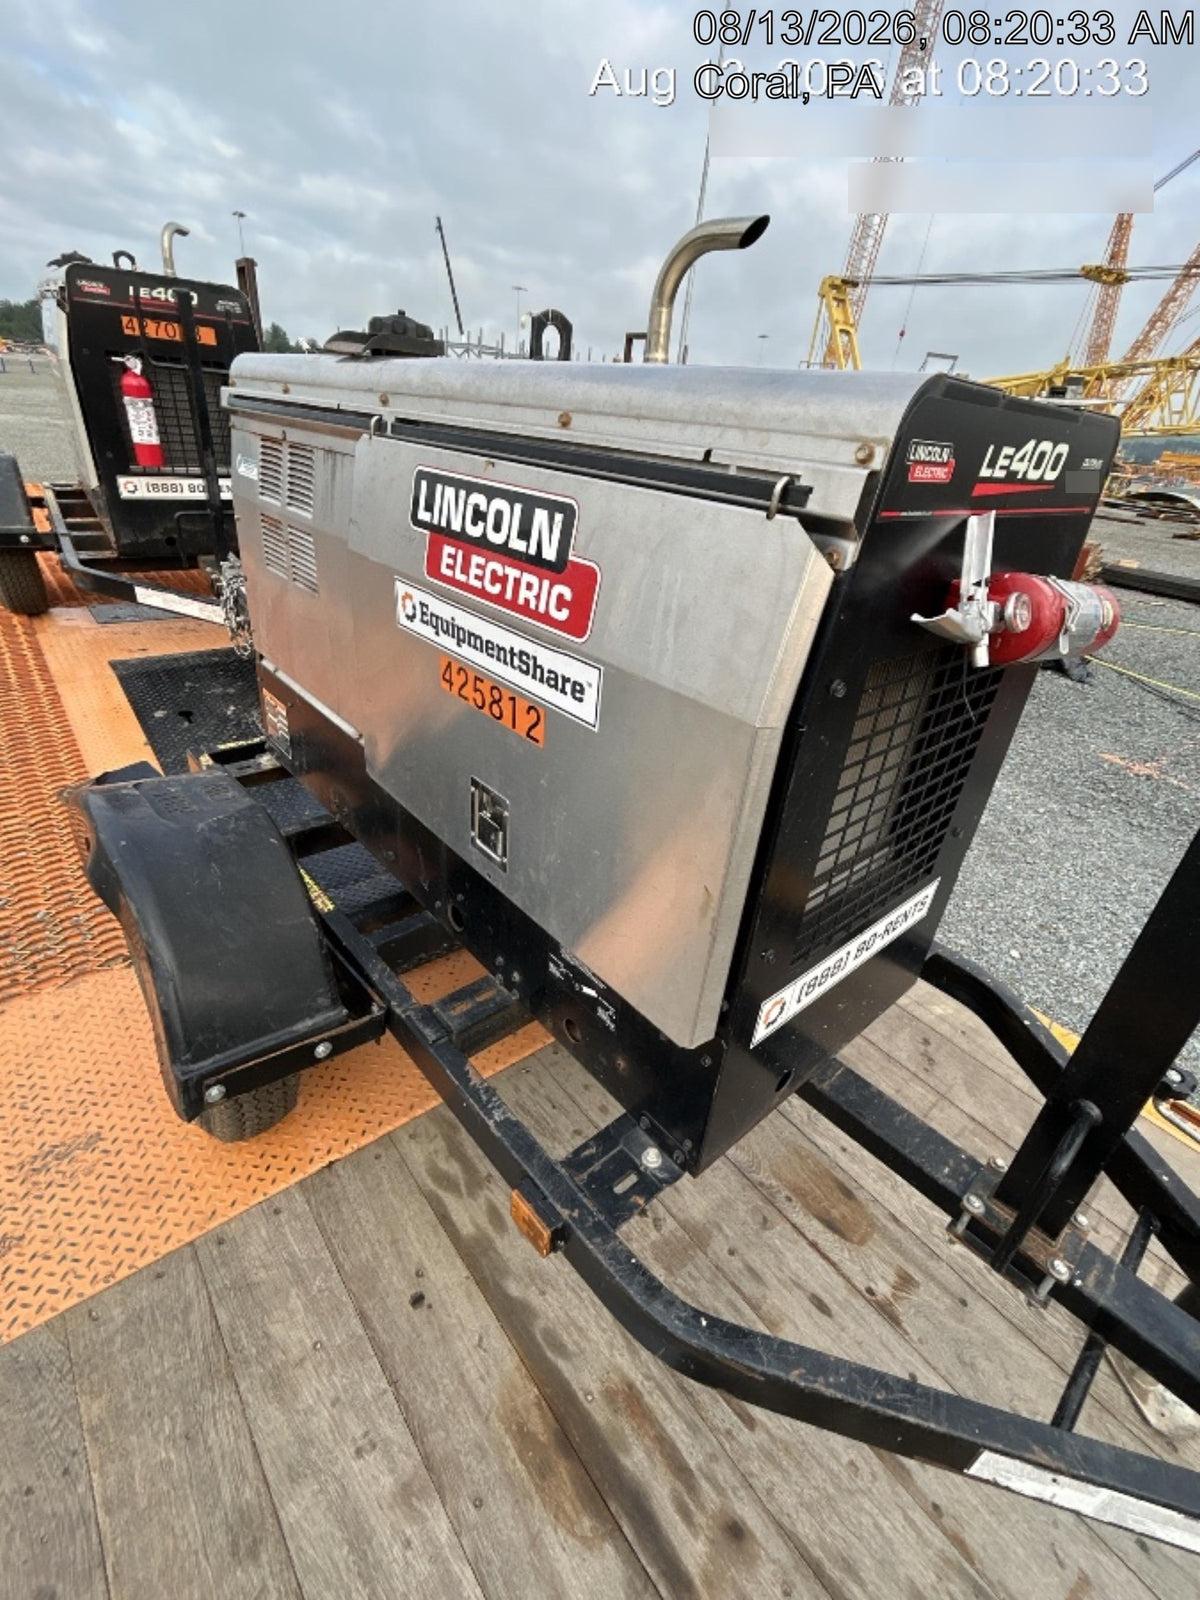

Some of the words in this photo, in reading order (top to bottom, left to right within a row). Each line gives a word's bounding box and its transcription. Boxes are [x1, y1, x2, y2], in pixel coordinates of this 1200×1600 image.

[909, 443, 951, 463] LINCOLN
[914, 465, 949, 479] ELECTRIC
[978, 438, 1070, 480] LE400
[145, 481, 184, 494] (888)
[416, 479, 564, 563] LINCOLN
[440, 543, 573, 622] ELECTRIC
[441, 660, 542, 744] 425812
[796, 950, 851, 1004] (888)
[853, 894, 930, 961] 80-RENTS
